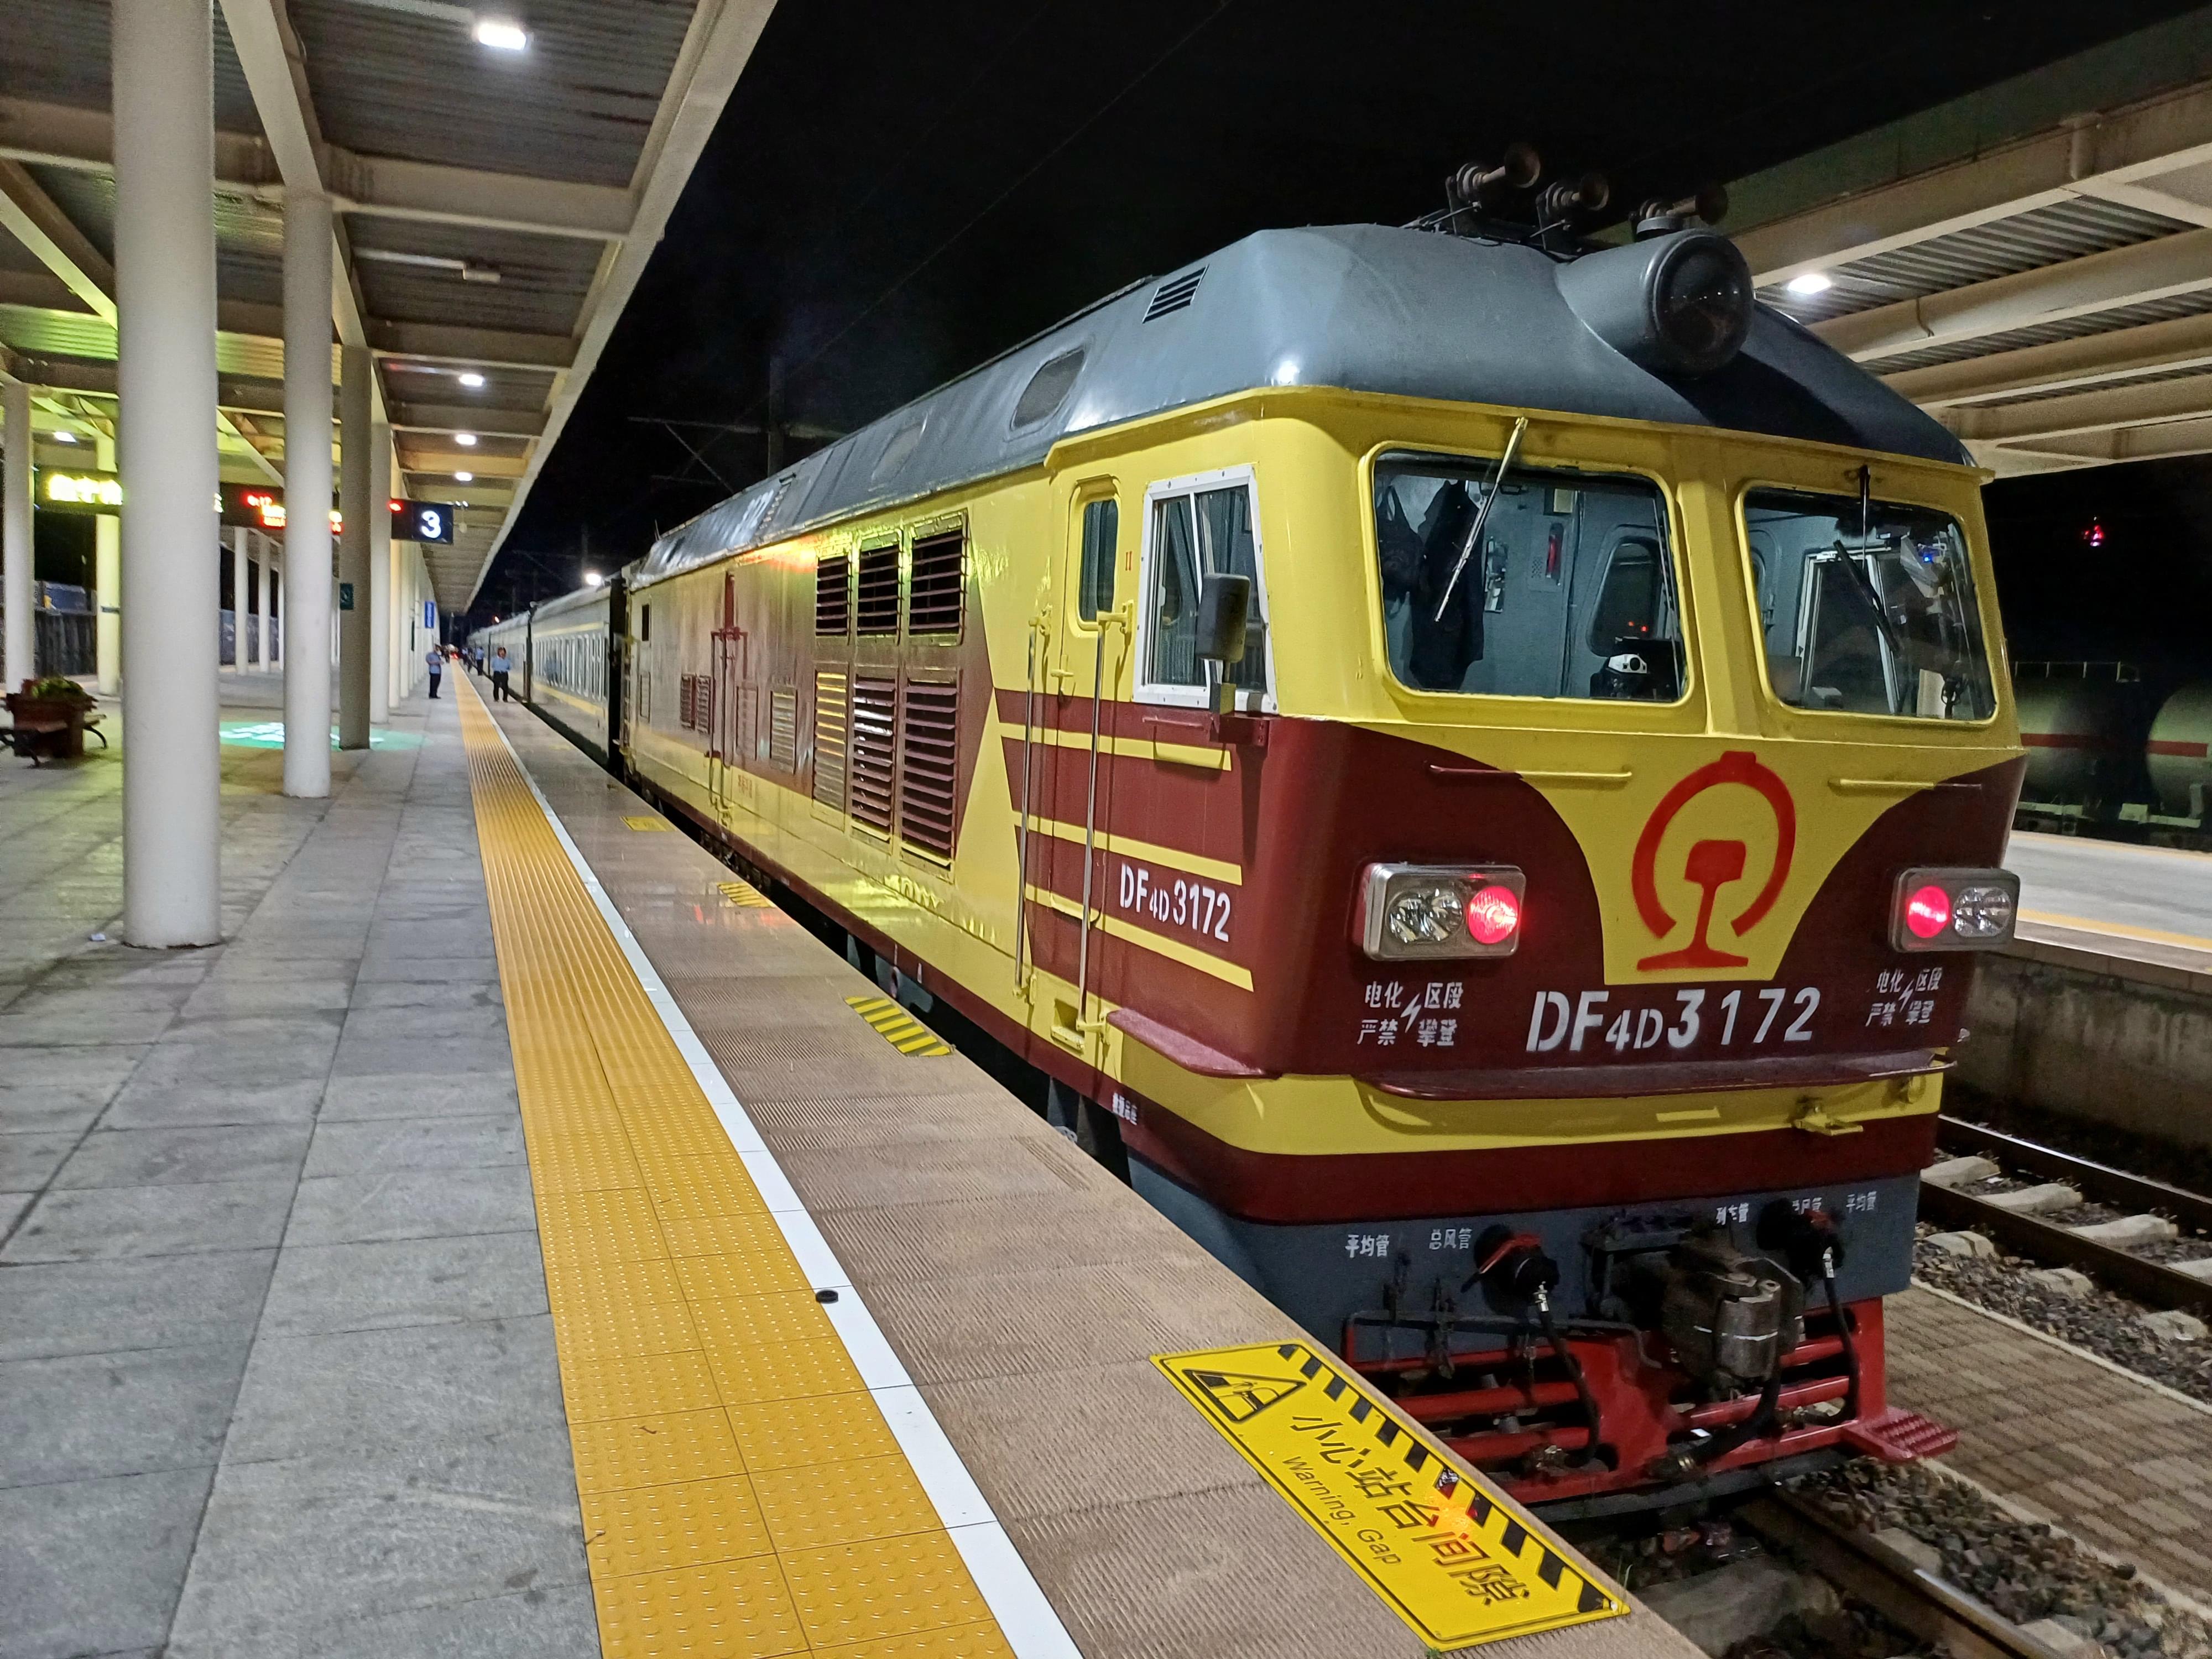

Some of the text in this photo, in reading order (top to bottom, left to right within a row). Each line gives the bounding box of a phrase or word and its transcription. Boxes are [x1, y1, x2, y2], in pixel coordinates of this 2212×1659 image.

[421, 510, 442, 539] 3
[1365, 981, 1464, 1009] 电化 区段
[1357, 1019, 1399, 1046] 严禁
[1345, 1234, 1390, 1258] 平均管
[1428, 1227, 1473, 1250] 总风管
[1282, 1455, 1402, 1566] Warning, Gap
[1289, 1415, 1531, 1606] 小心站台间隙
